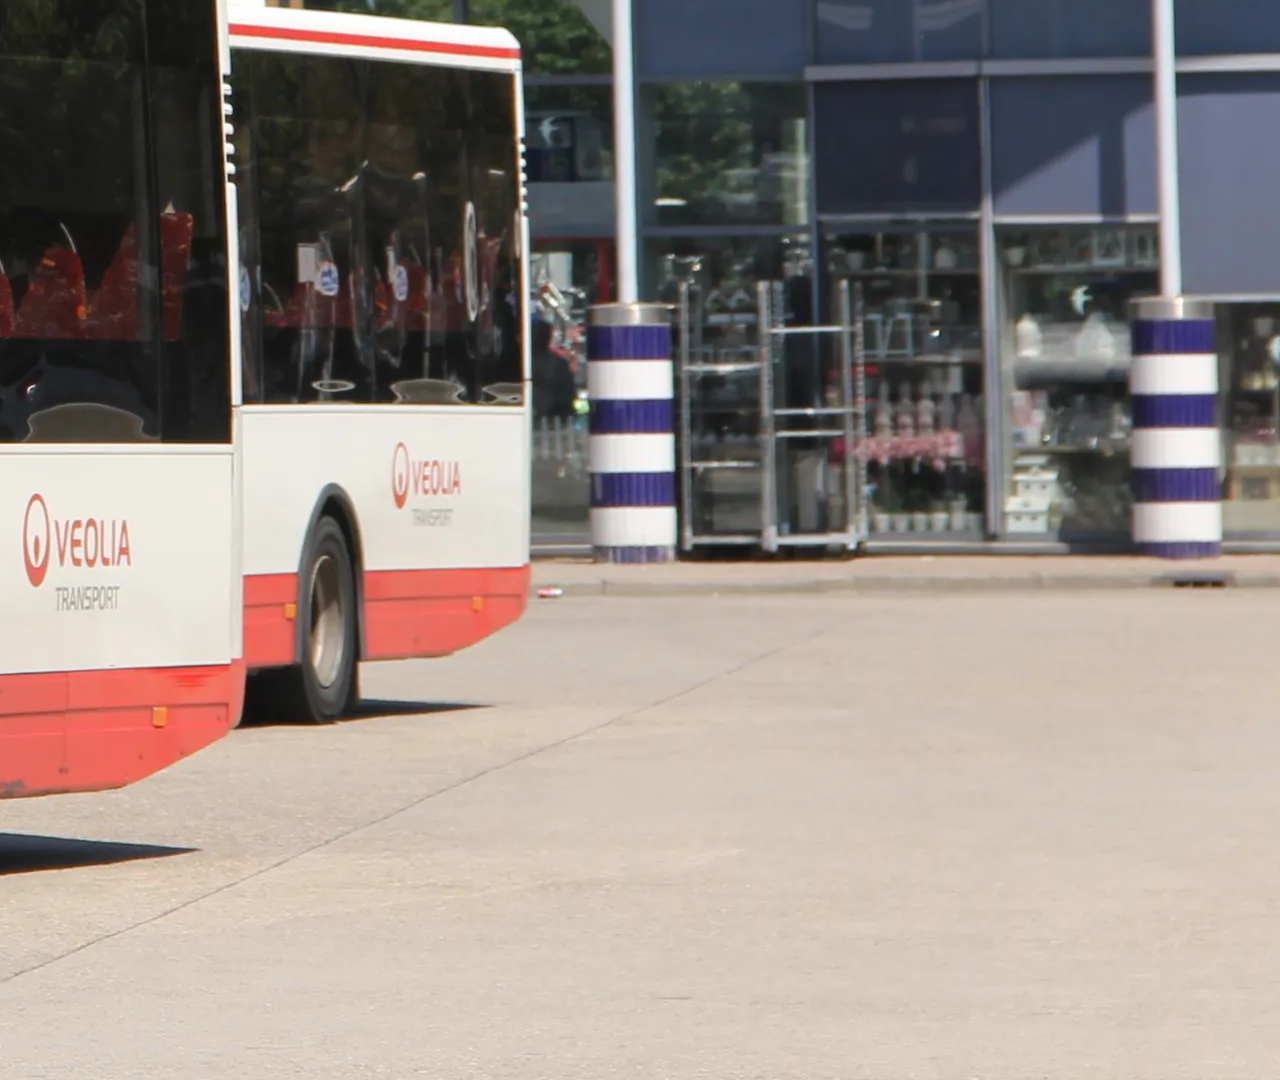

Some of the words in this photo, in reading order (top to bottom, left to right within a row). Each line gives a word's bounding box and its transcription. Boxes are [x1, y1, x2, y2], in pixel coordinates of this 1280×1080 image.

[411, 460, 462, 495] VEOLIA
[53, 518, 132, 568] VEOLIA
[54, 586, 121, 611] TRANSPORT
